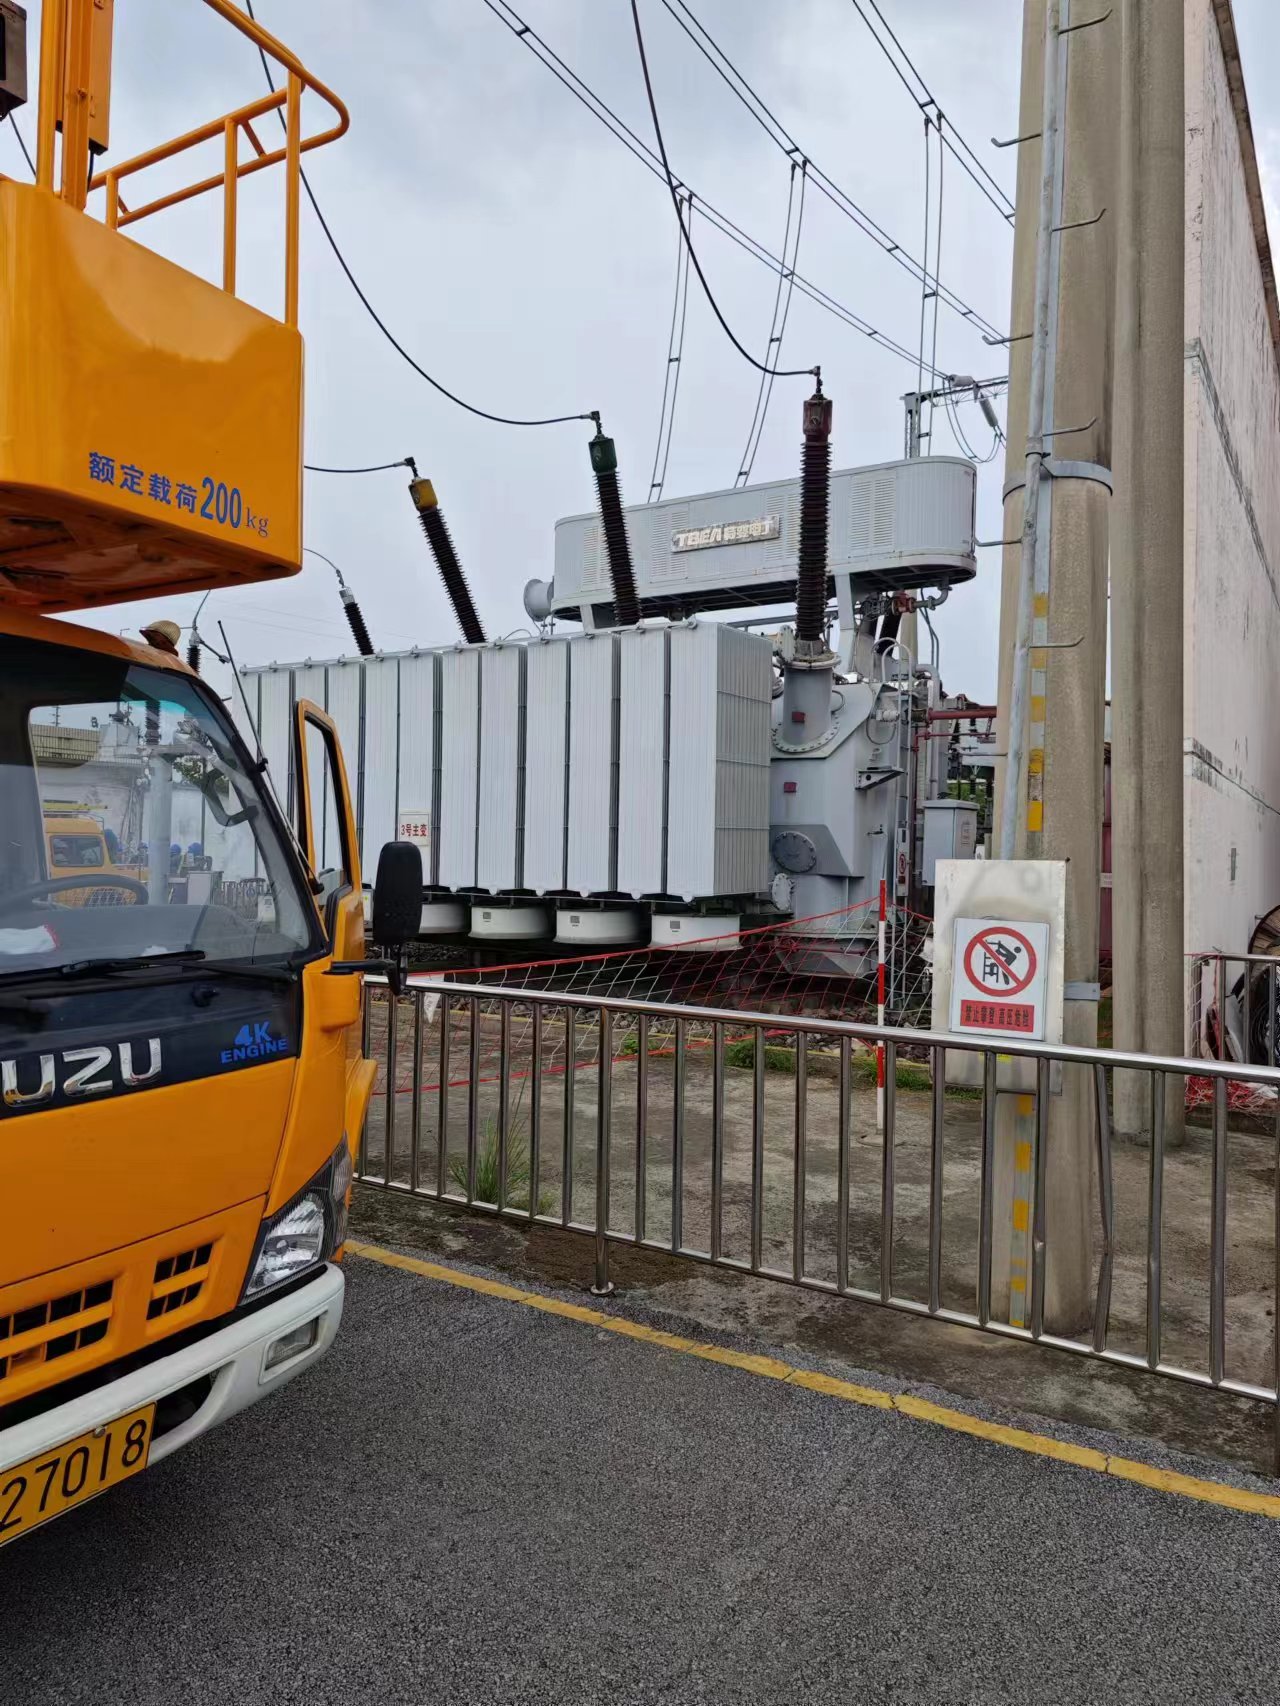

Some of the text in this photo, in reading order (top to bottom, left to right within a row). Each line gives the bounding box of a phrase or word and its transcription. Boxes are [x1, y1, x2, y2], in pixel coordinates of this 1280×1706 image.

[234, 1021, 273, 1047] 4K
[221, 1038, 289, 1065] ENGINE
[0, 1419, 148, 1533] 27018
